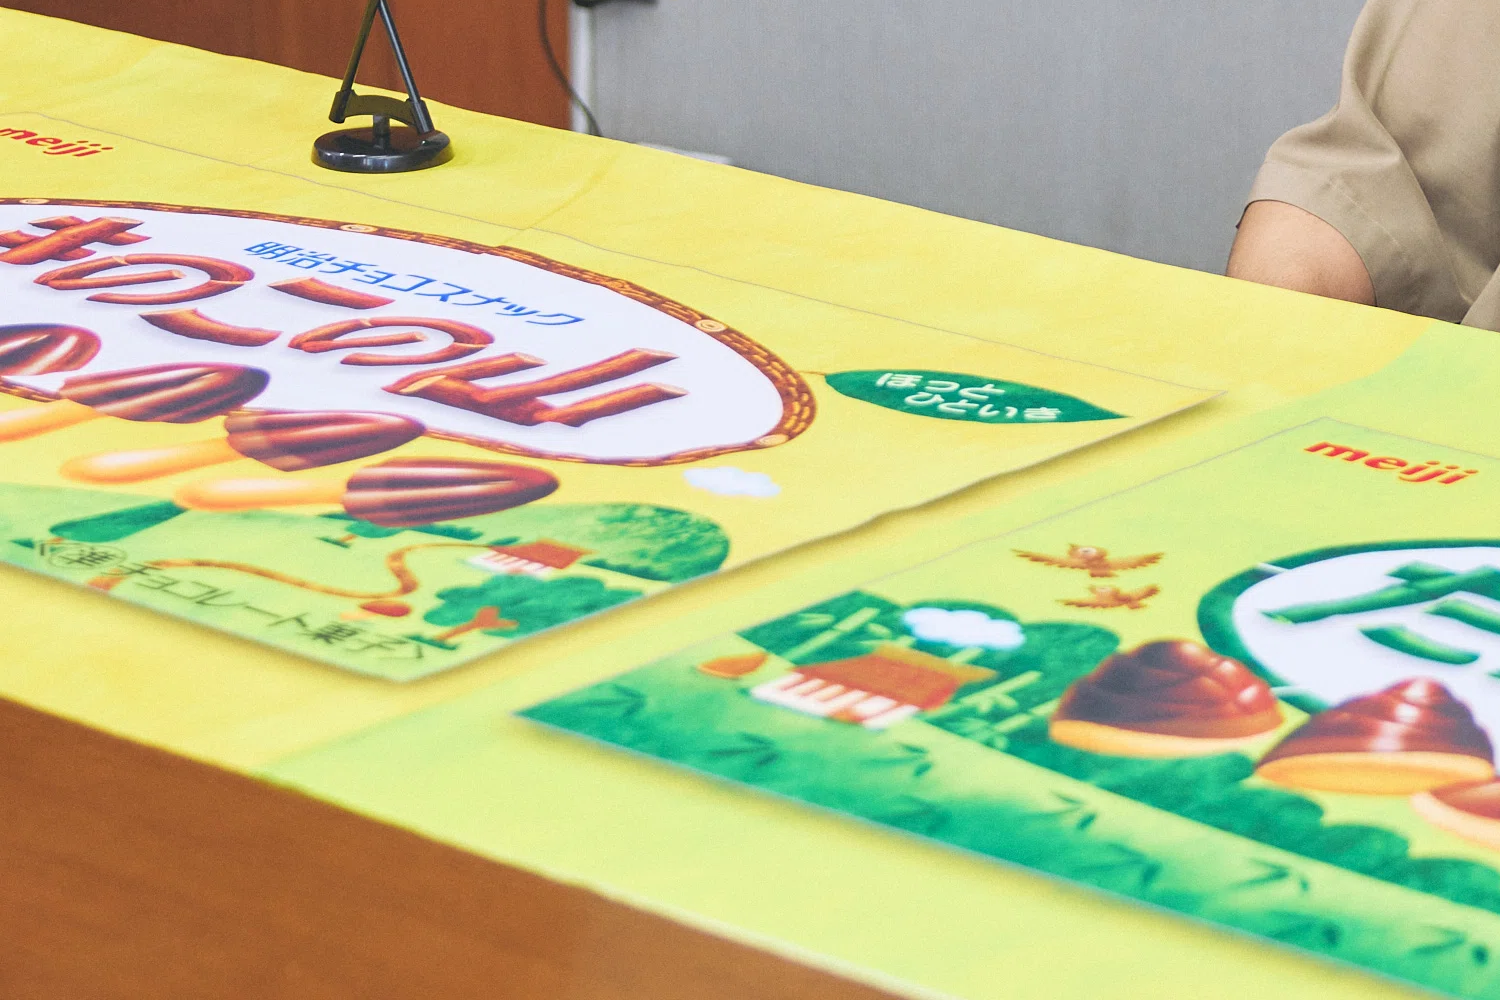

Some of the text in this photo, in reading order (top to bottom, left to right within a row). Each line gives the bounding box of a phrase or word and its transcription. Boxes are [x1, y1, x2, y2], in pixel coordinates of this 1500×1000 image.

[0, 128, 114, 157] meiji
[243, 241, 586, 327] 明治チョコスナック
[875, 372, 1006, 401] ほっと
[904, 391, 1063, 422] ひといき
[1303, 441, 1480, 485] meiji
